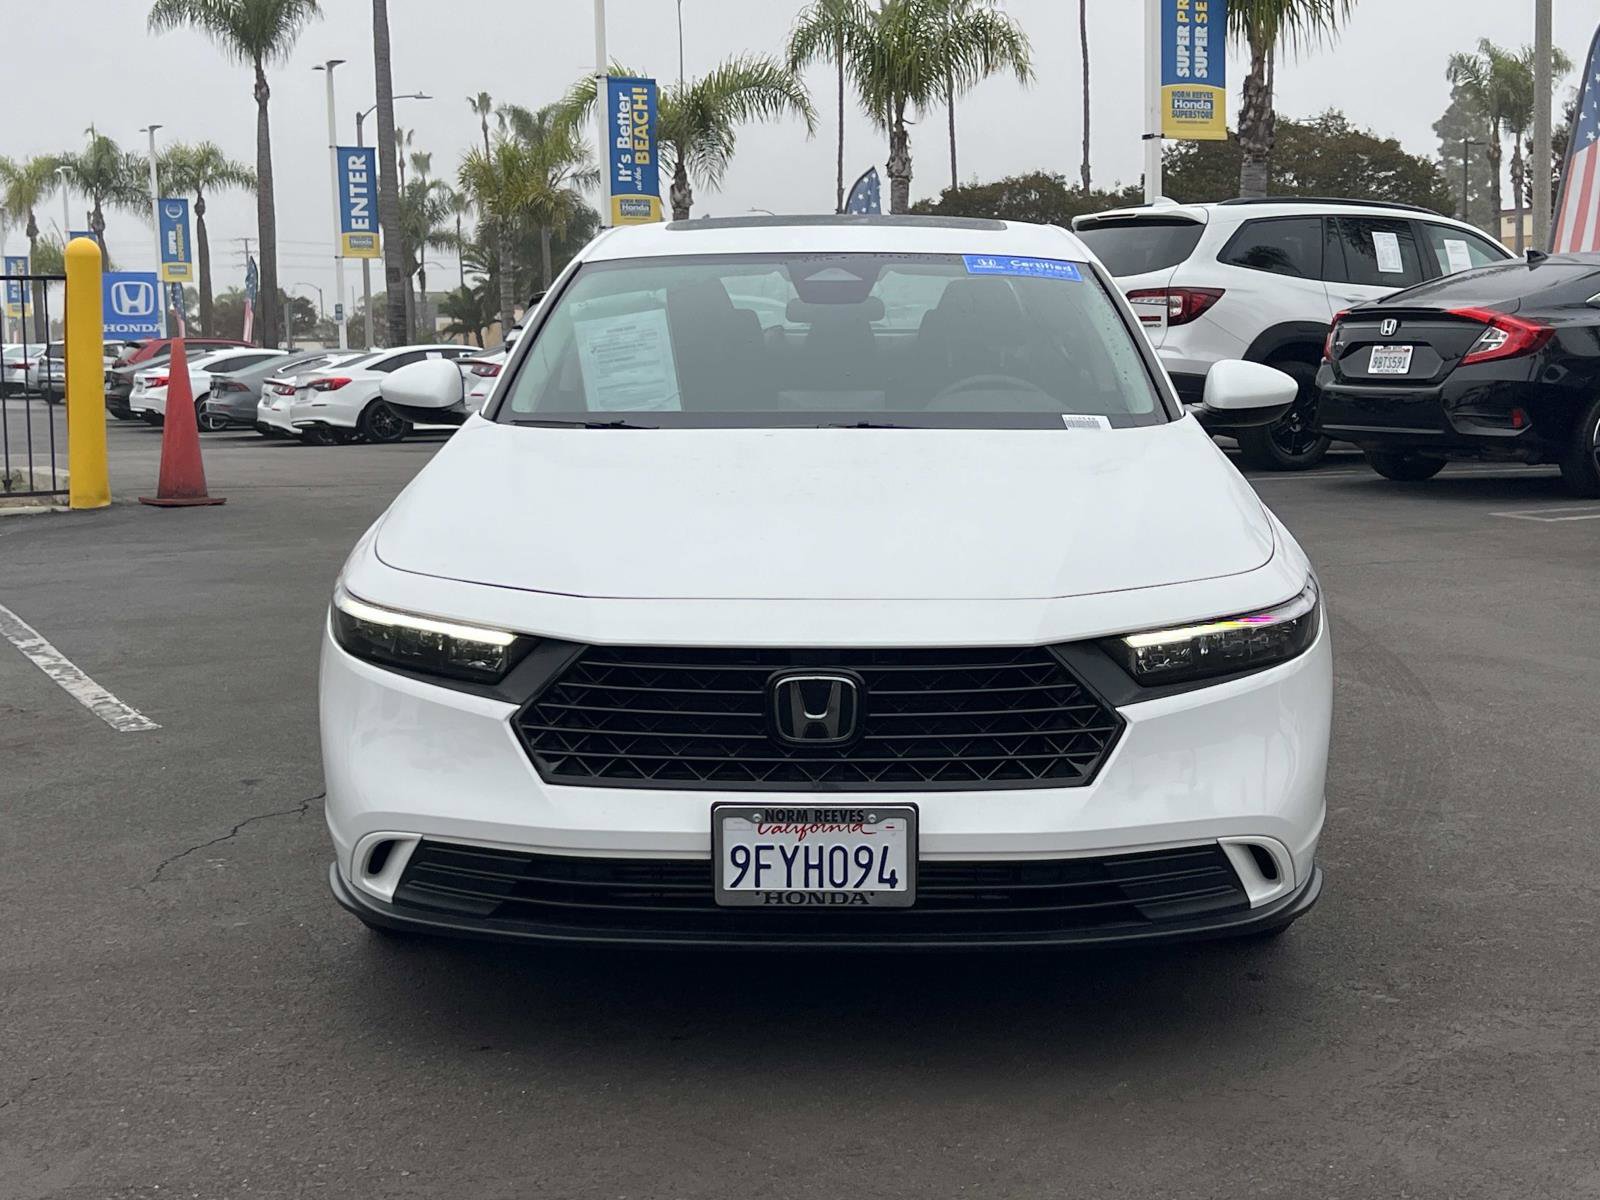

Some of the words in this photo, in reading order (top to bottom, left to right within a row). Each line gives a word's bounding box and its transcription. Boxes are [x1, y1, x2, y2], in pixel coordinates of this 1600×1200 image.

[1176, 25, 1190, 78] SUPER
[1194, 26, 1208, 79] SUPER
[1174, 99, 1211, 108] Honda
[617, 93, 632, 148] Better
[633, 88, 649, 164] BEACH!
[618, 155, 632, 181] It's
[347, 154, 370, 230] ENTER
[1009, 259, 1073, 272] Certified
[103, 323, 161, 333] HONDA
[764, 809, 809, 822] NORM
[814, 809, 865, 822] REEVES
[757, 822, 877, 842] California
[729, 844, 899, 889] 9FYH094
[763, 891, 871, 905] HONDA
